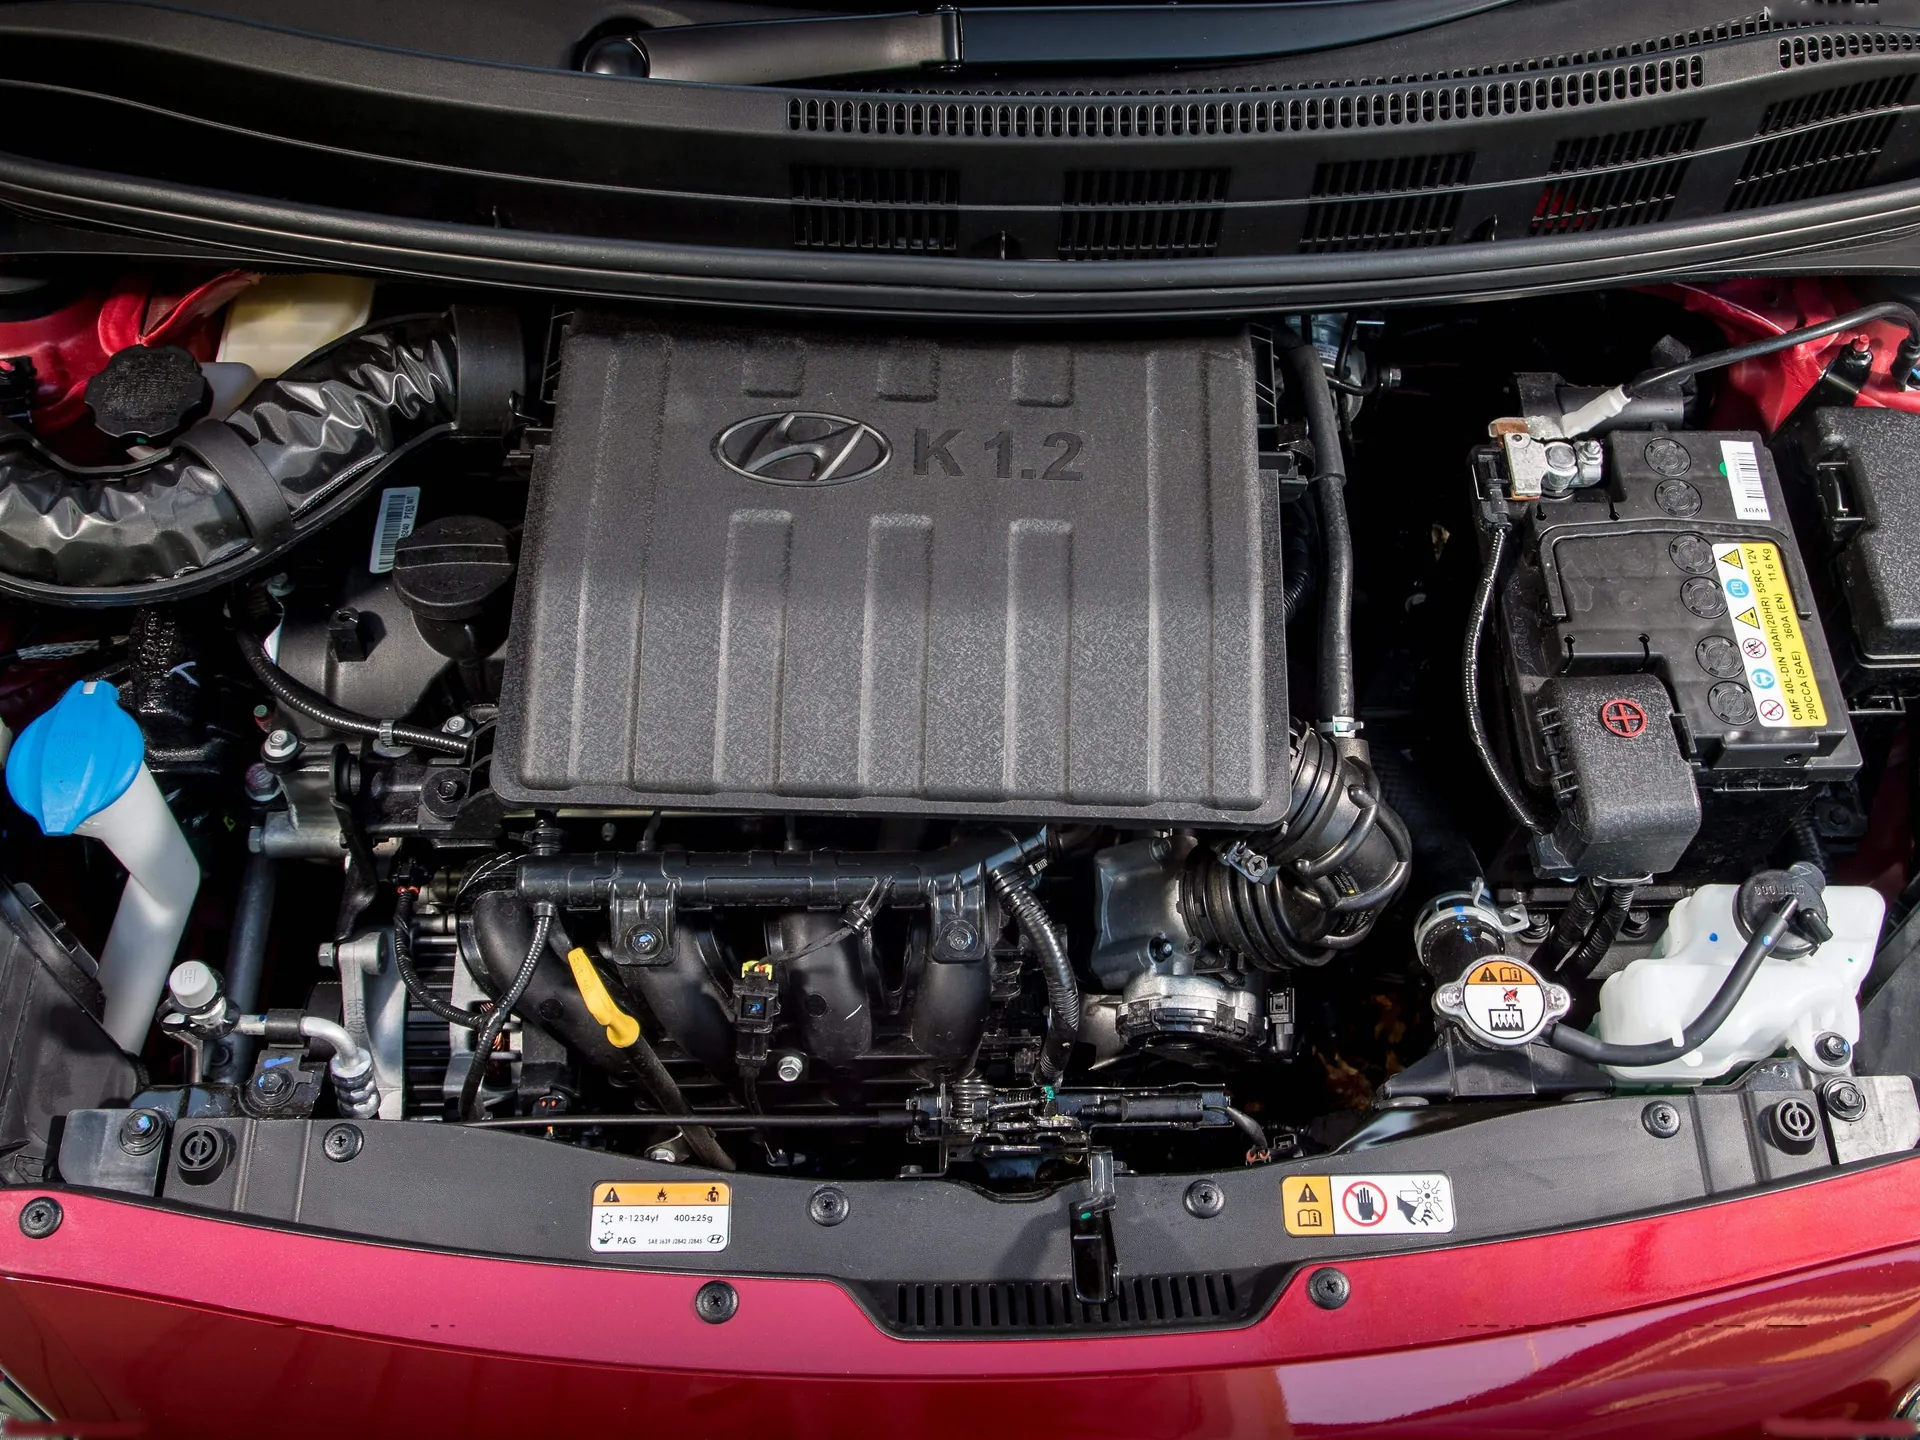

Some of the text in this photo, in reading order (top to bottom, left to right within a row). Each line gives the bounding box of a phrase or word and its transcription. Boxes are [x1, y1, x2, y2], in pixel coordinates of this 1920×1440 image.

[913, 428, 1084, 482] K 1.2
[1746, 548, 1803, 720] CMF 40L-DIN 40Ah(20HR) 55RC 12V
[1763, 548, 1818, 720] 290CCA (SAE) 360A (EN) 11.6 Kg
[617, 1236, 637, 1245] PAG
[618, 1214, 713, 1223] R-1234yf 400±25g
